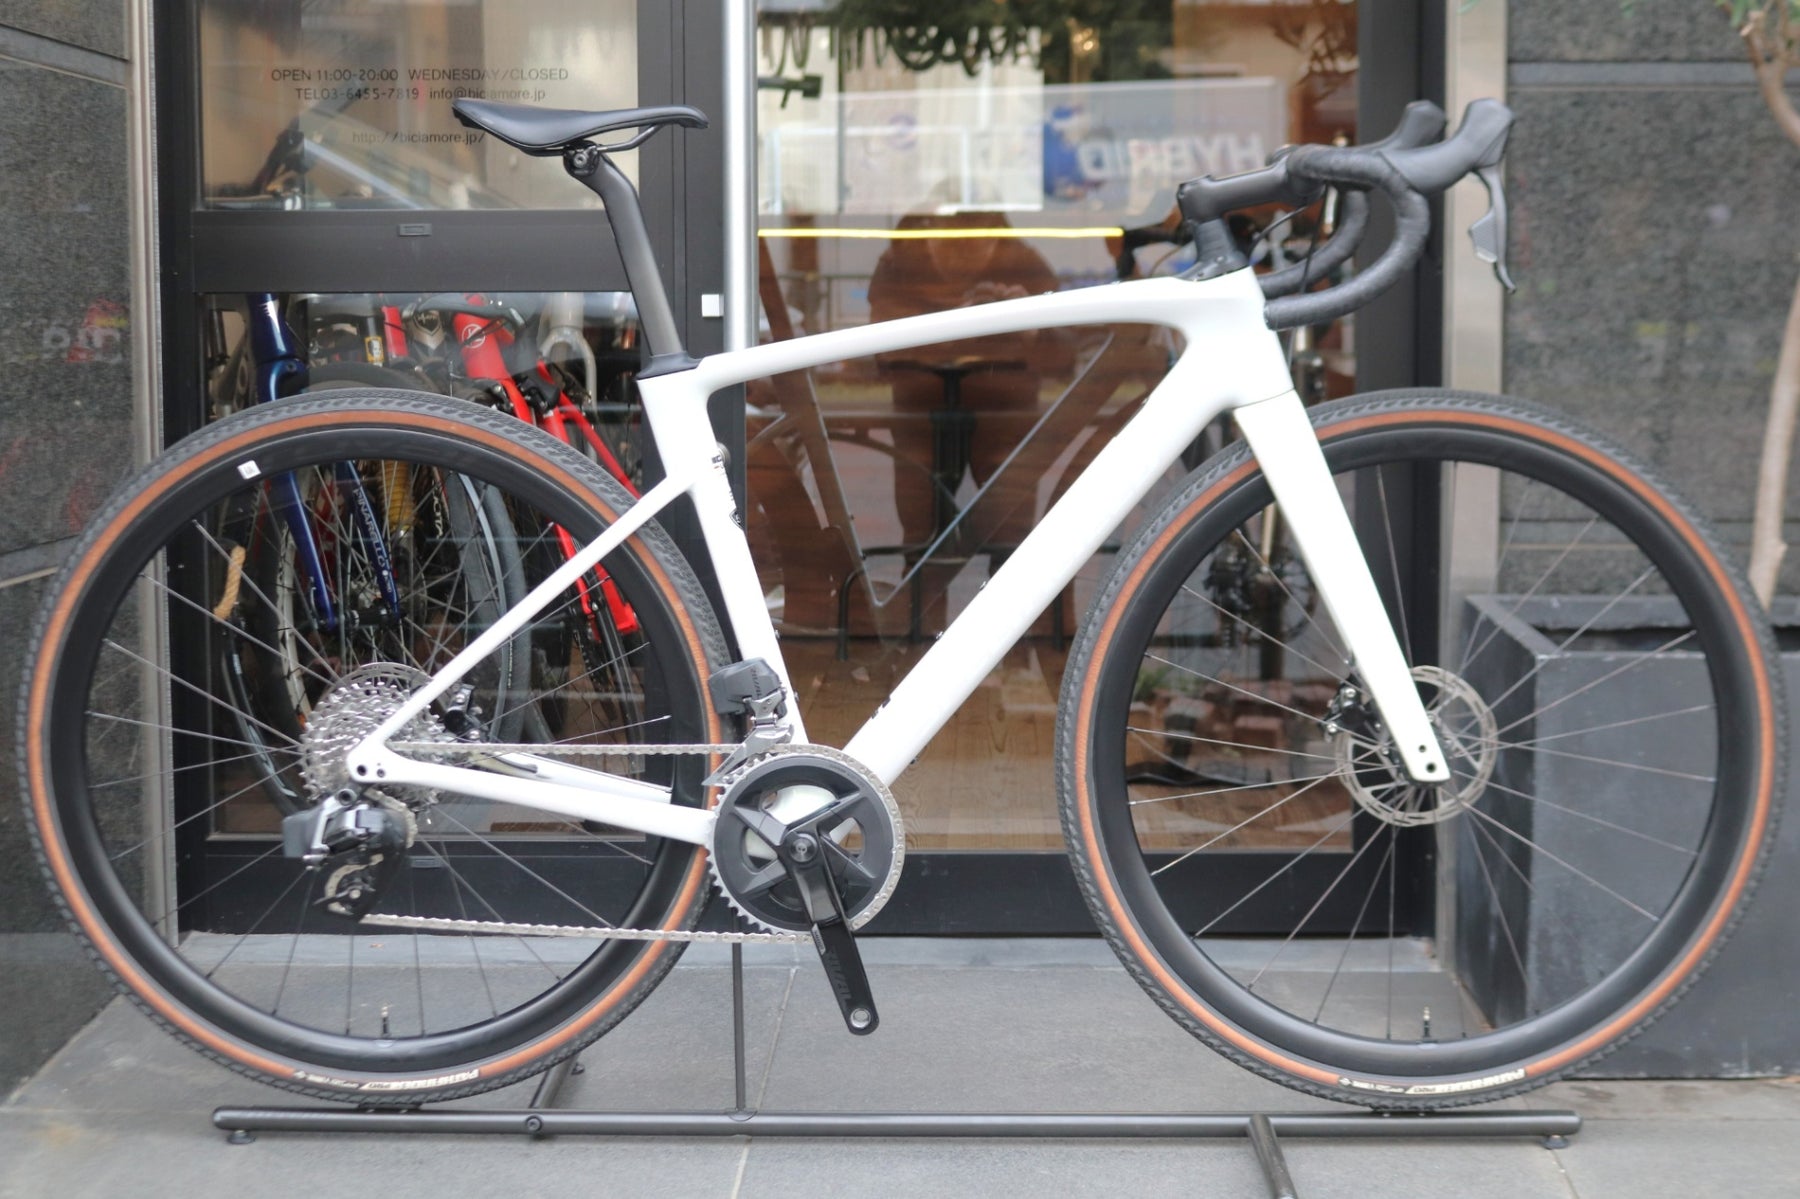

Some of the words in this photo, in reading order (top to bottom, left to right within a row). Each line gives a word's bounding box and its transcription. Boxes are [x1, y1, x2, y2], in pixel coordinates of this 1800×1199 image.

[271, 69, 311, 81] OPEN
[317, 69, 398, 81] 11:00-20:00
[430, 87, 545, 101] info@biciamore.jp
[353, 486, 386, 567] PINARELLO
